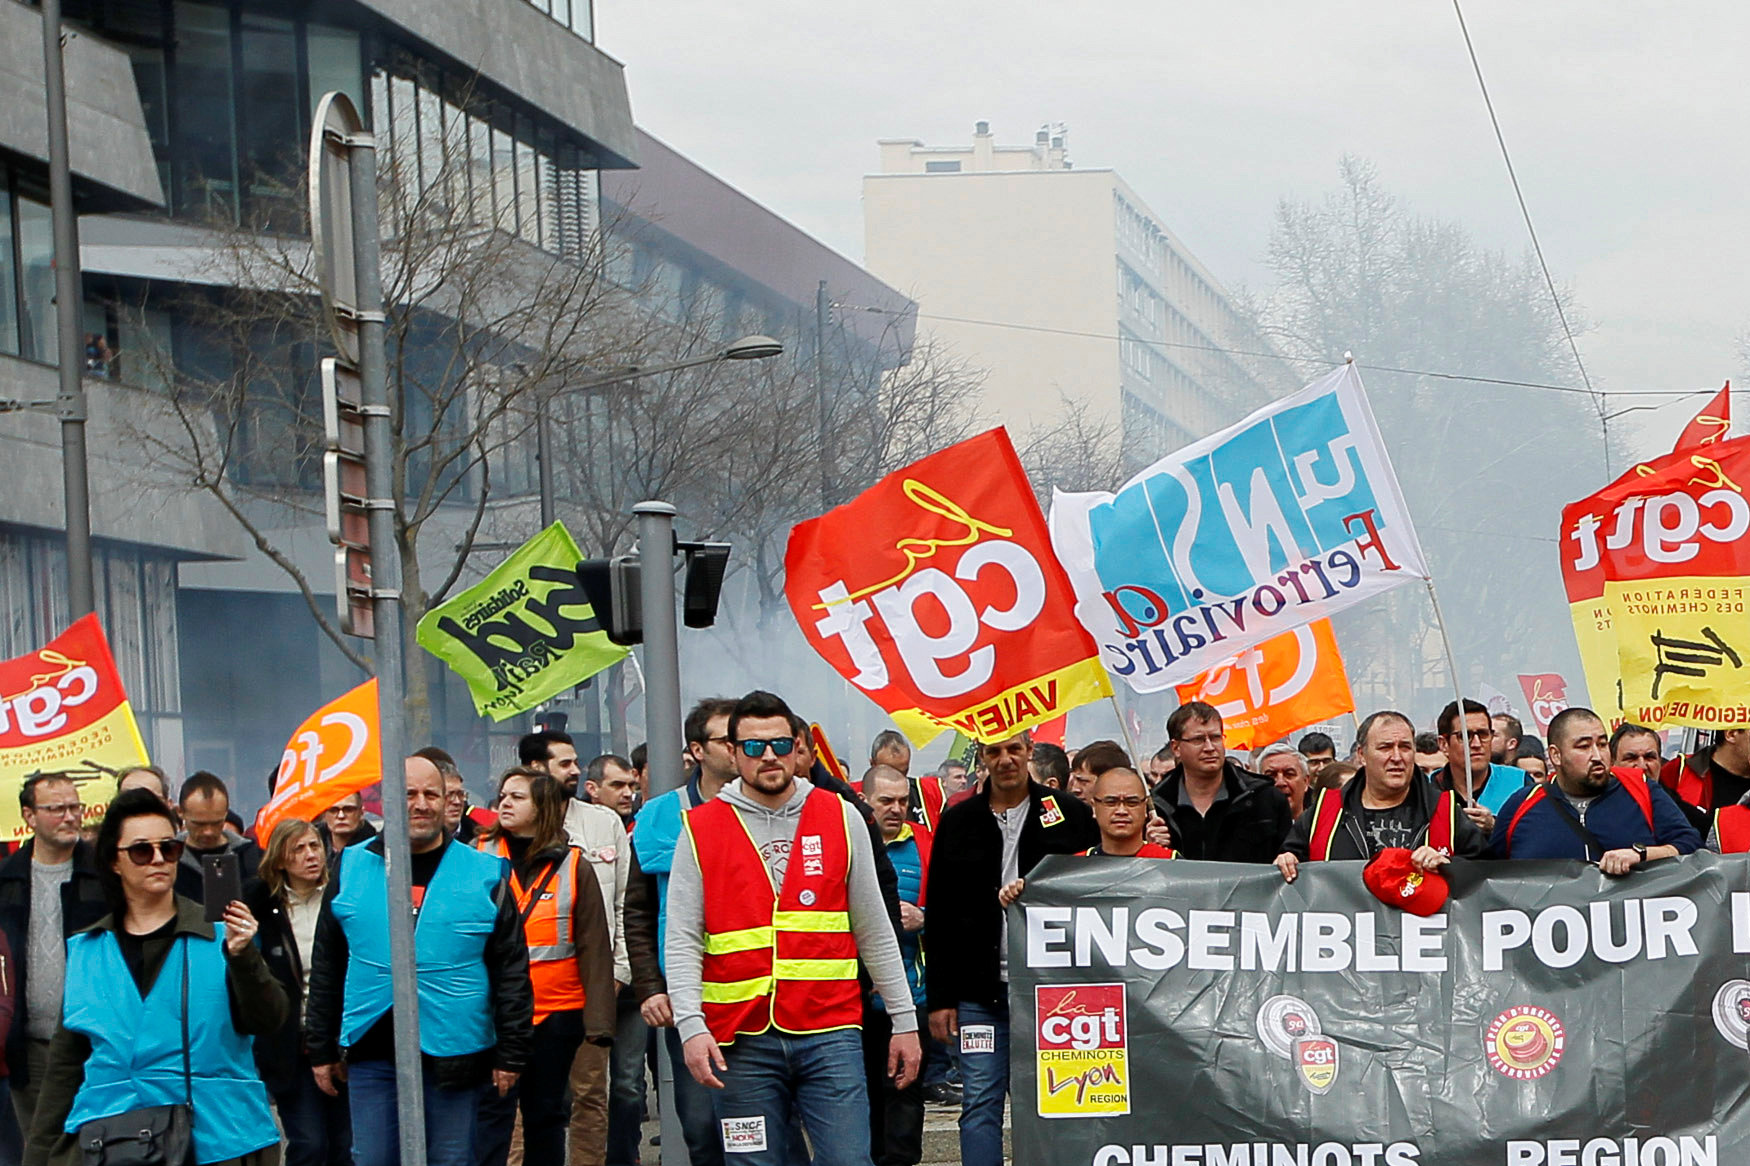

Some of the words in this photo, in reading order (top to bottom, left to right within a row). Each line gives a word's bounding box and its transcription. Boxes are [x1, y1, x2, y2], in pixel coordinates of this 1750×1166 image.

[1026, 906, 1448, 972] ENSEMBLE
[1482, 896, 1699, 971] POUR
[1041, 1007, 1120, 1051] cgt
[1041, 1049, 1125, 1061] CHEMINOTS
[1303, 1047, 1333, 1064] cgt
[1047, 1063, 1121, 1105] Lyon
[1090, 1094, 1127, 1104] REGION
[736, 1120, 762, 1130] SNCF
